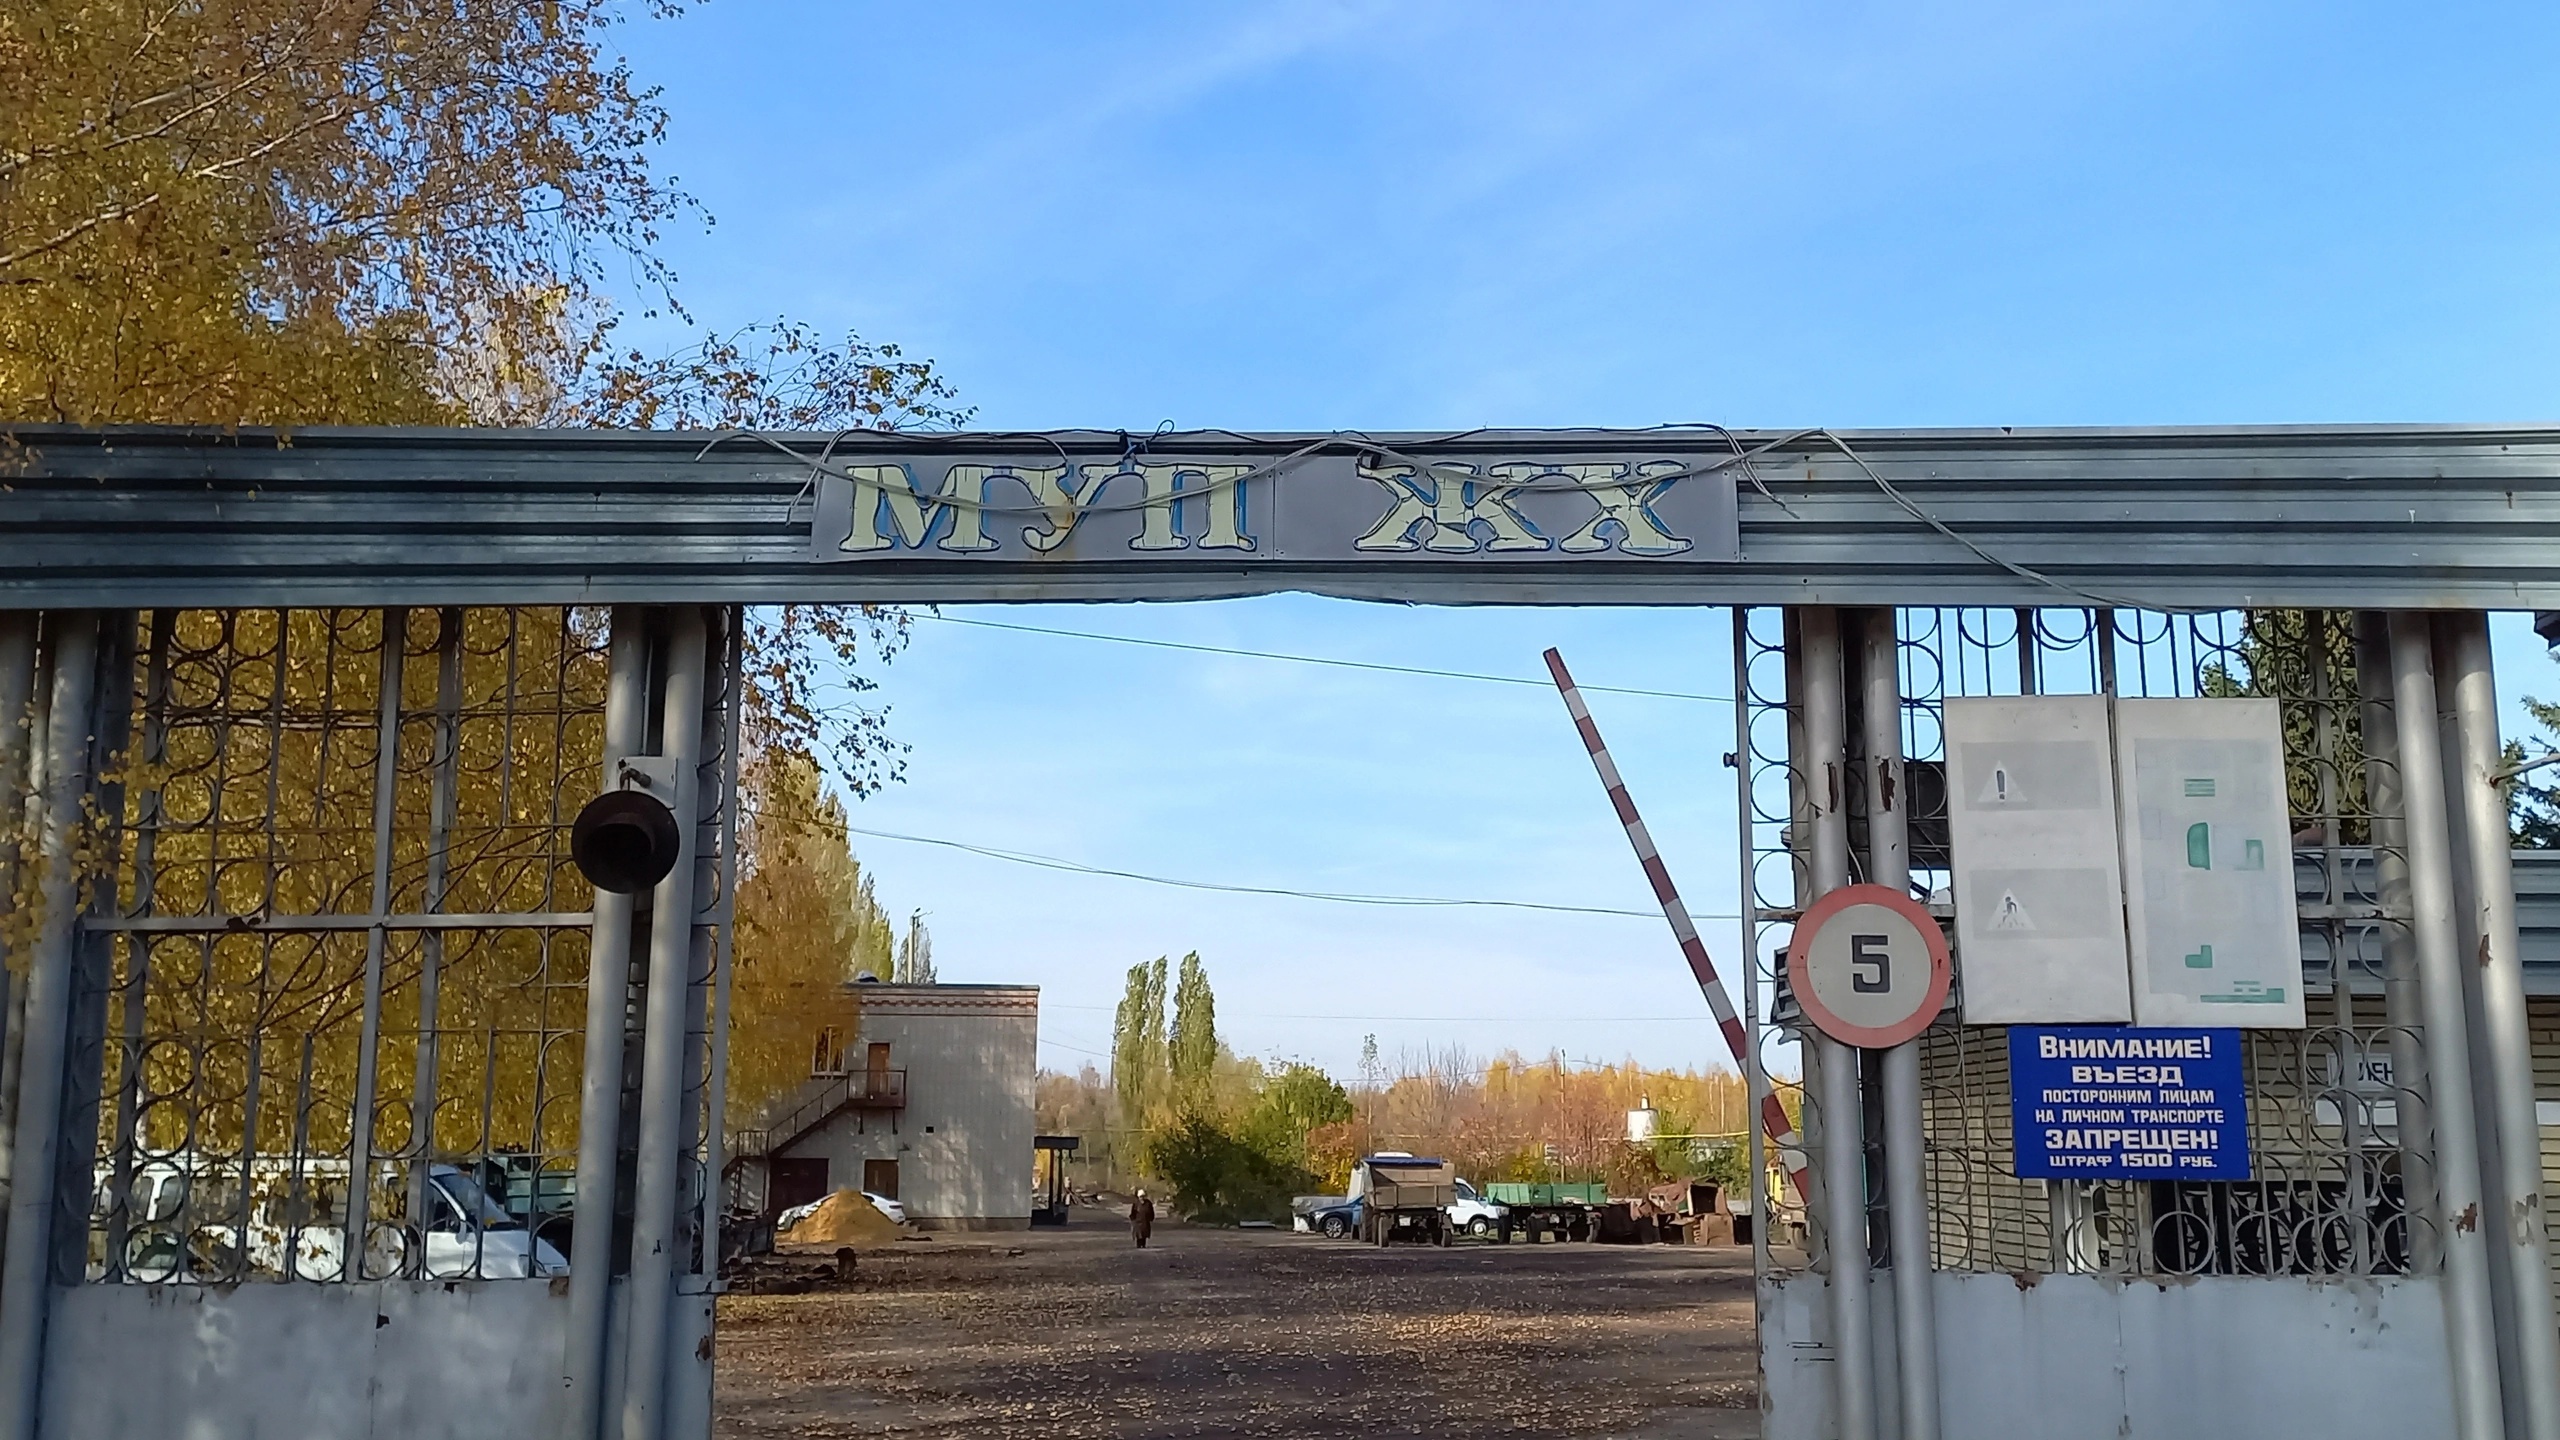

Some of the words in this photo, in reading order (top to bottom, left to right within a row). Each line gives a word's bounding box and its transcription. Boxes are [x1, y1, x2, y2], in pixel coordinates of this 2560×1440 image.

[838, 462, 1258, 553] МУП
[1353, 460, 1694, 557] ЖХ
[1851, 934, 1891, 993] 5
[2039, 1035, 2212, 1059] ВНИМАНИЕ!
[2071, 1066, 2184, 1087] ВЪЕЗД
[2042, 1089, 2152, 1104] ПОСТОРОННИМ
[2159, 1089, 2215, 1107] ЛИЦАМ
[2035, 1109, 2055, 1123] НА
[2061, 1109, 2125, 1123] ЛИЧНОМ
[2130, 1109, 2224, 1124] ТРАНСПОРТЕ
[2045, 1129, 2219, 1152] ЗАПРЕЩЕН!
[2049, 1155, 2113, 1167] ШТРАФ
[2119, 1153, 2173, 1167] 1500
[2179, 1156, 2218, 1168] РУБ.
